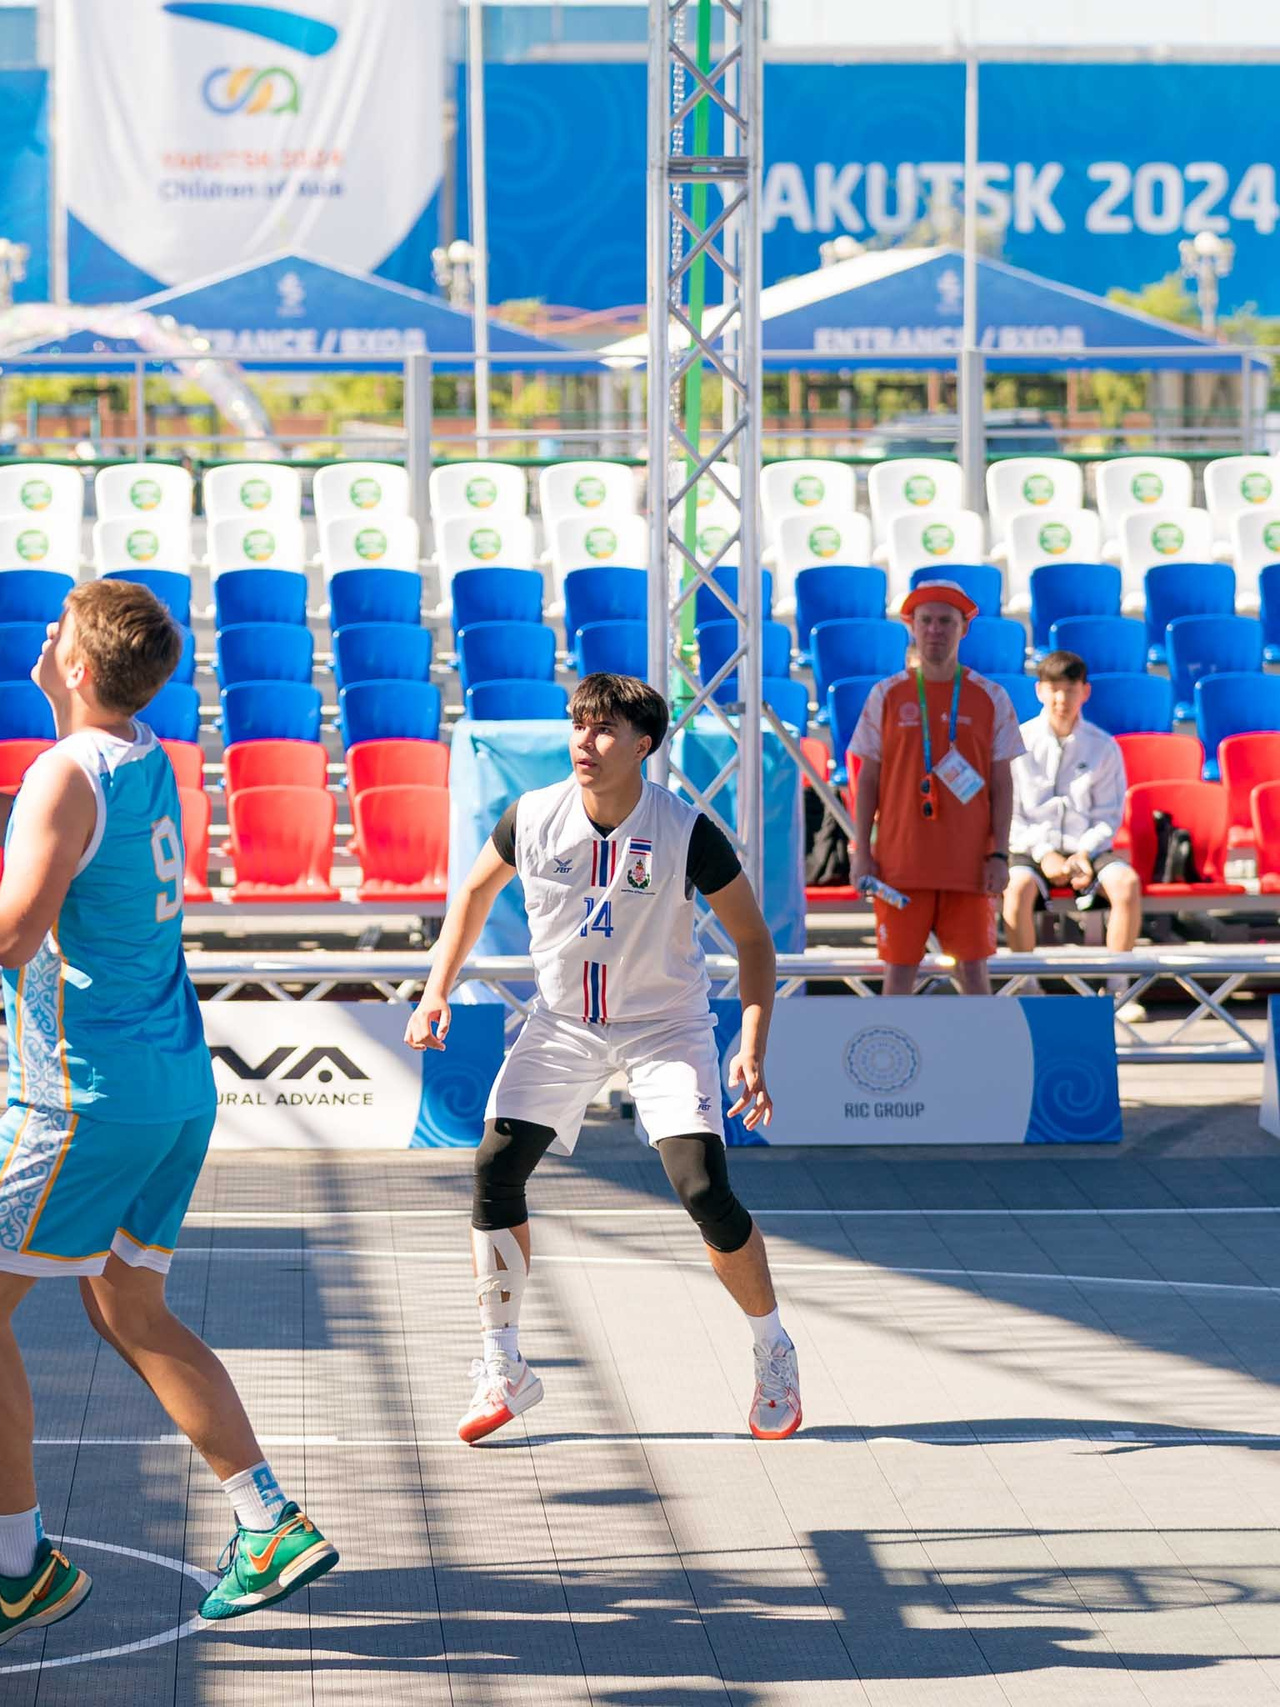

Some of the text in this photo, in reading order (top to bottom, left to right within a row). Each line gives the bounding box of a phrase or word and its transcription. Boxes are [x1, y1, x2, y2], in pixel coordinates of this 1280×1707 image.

[760, 161, 1280, 235] AKUTSK 2024
[814, 327, 965, 353] ENTRANC
[151, 815, 184, 922] 9
[580, 897, 614, 938] 14
[274, 1092, 374, 1106] ADVANCE
[844, 1101, 925, 1118] RIC GROUP
